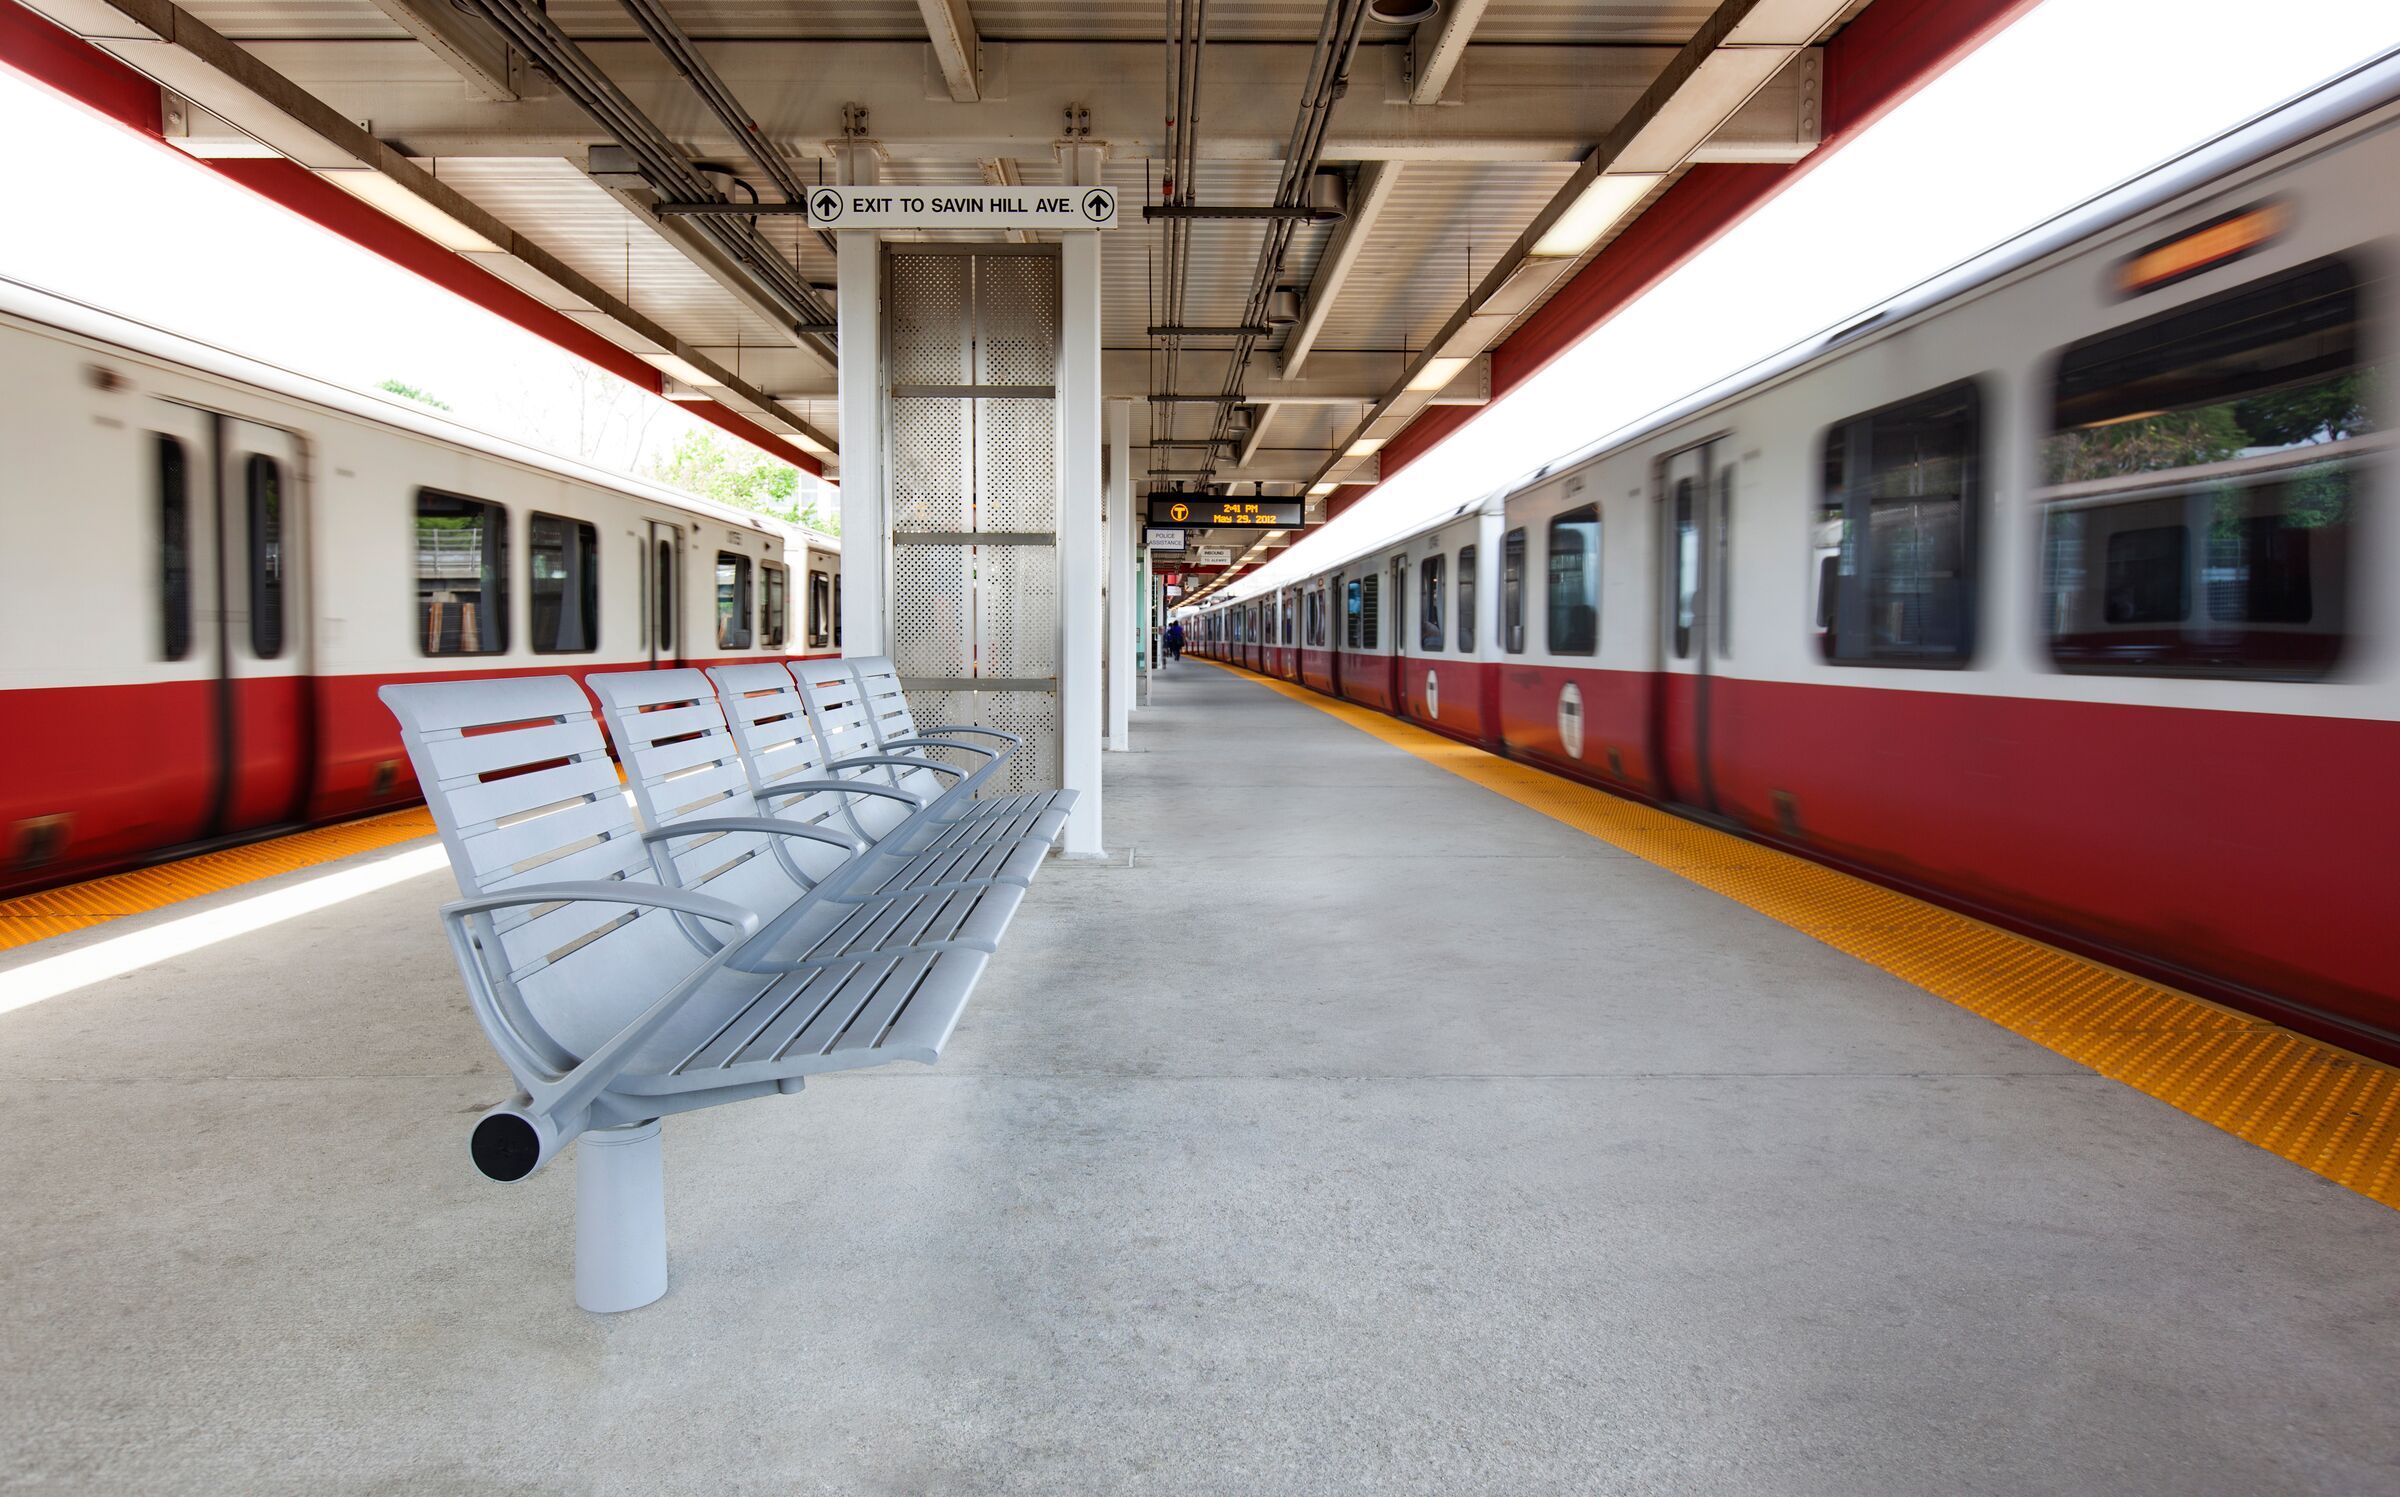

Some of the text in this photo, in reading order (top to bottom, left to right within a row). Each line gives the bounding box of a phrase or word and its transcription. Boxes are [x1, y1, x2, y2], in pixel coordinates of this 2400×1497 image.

[853, 197, 1073, 212] EXIT TO SAVIN HILL AVE.
[1174, 507, 1185, 519] T
[1223, 504, 1259, 513] 2:41 PM
[1213, 514, 1232, 523] May
[1255, 515, 1277, 524] 2012
